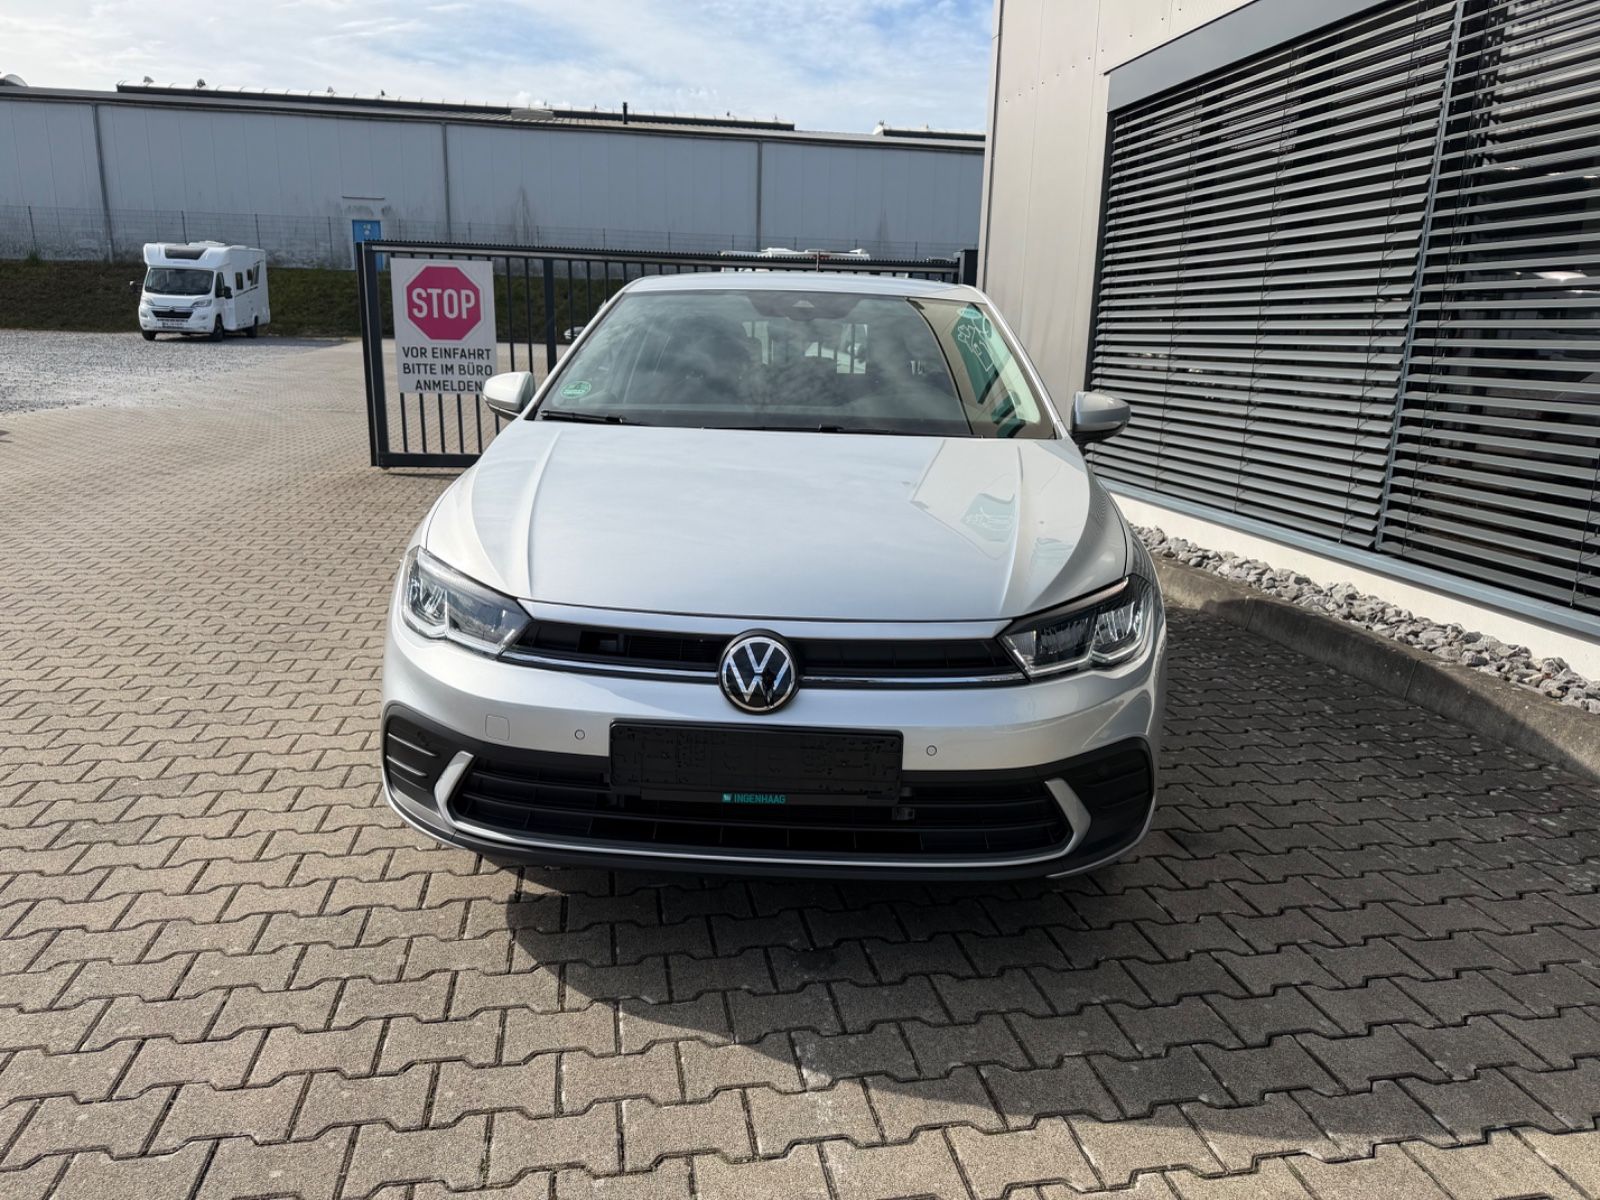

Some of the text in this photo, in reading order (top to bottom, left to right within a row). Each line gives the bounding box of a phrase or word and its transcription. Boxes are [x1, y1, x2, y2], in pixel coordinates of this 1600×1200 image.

[412, 287, 476, 319] STOP
[402, 346, 492, 361] VOR EINFAHRT
[402, 362, 493, 376] BITTE IM BÜRO
[415, 380, 483, 392] ANMELDEN
[734, 793, 786, 804] INGENHAAG
